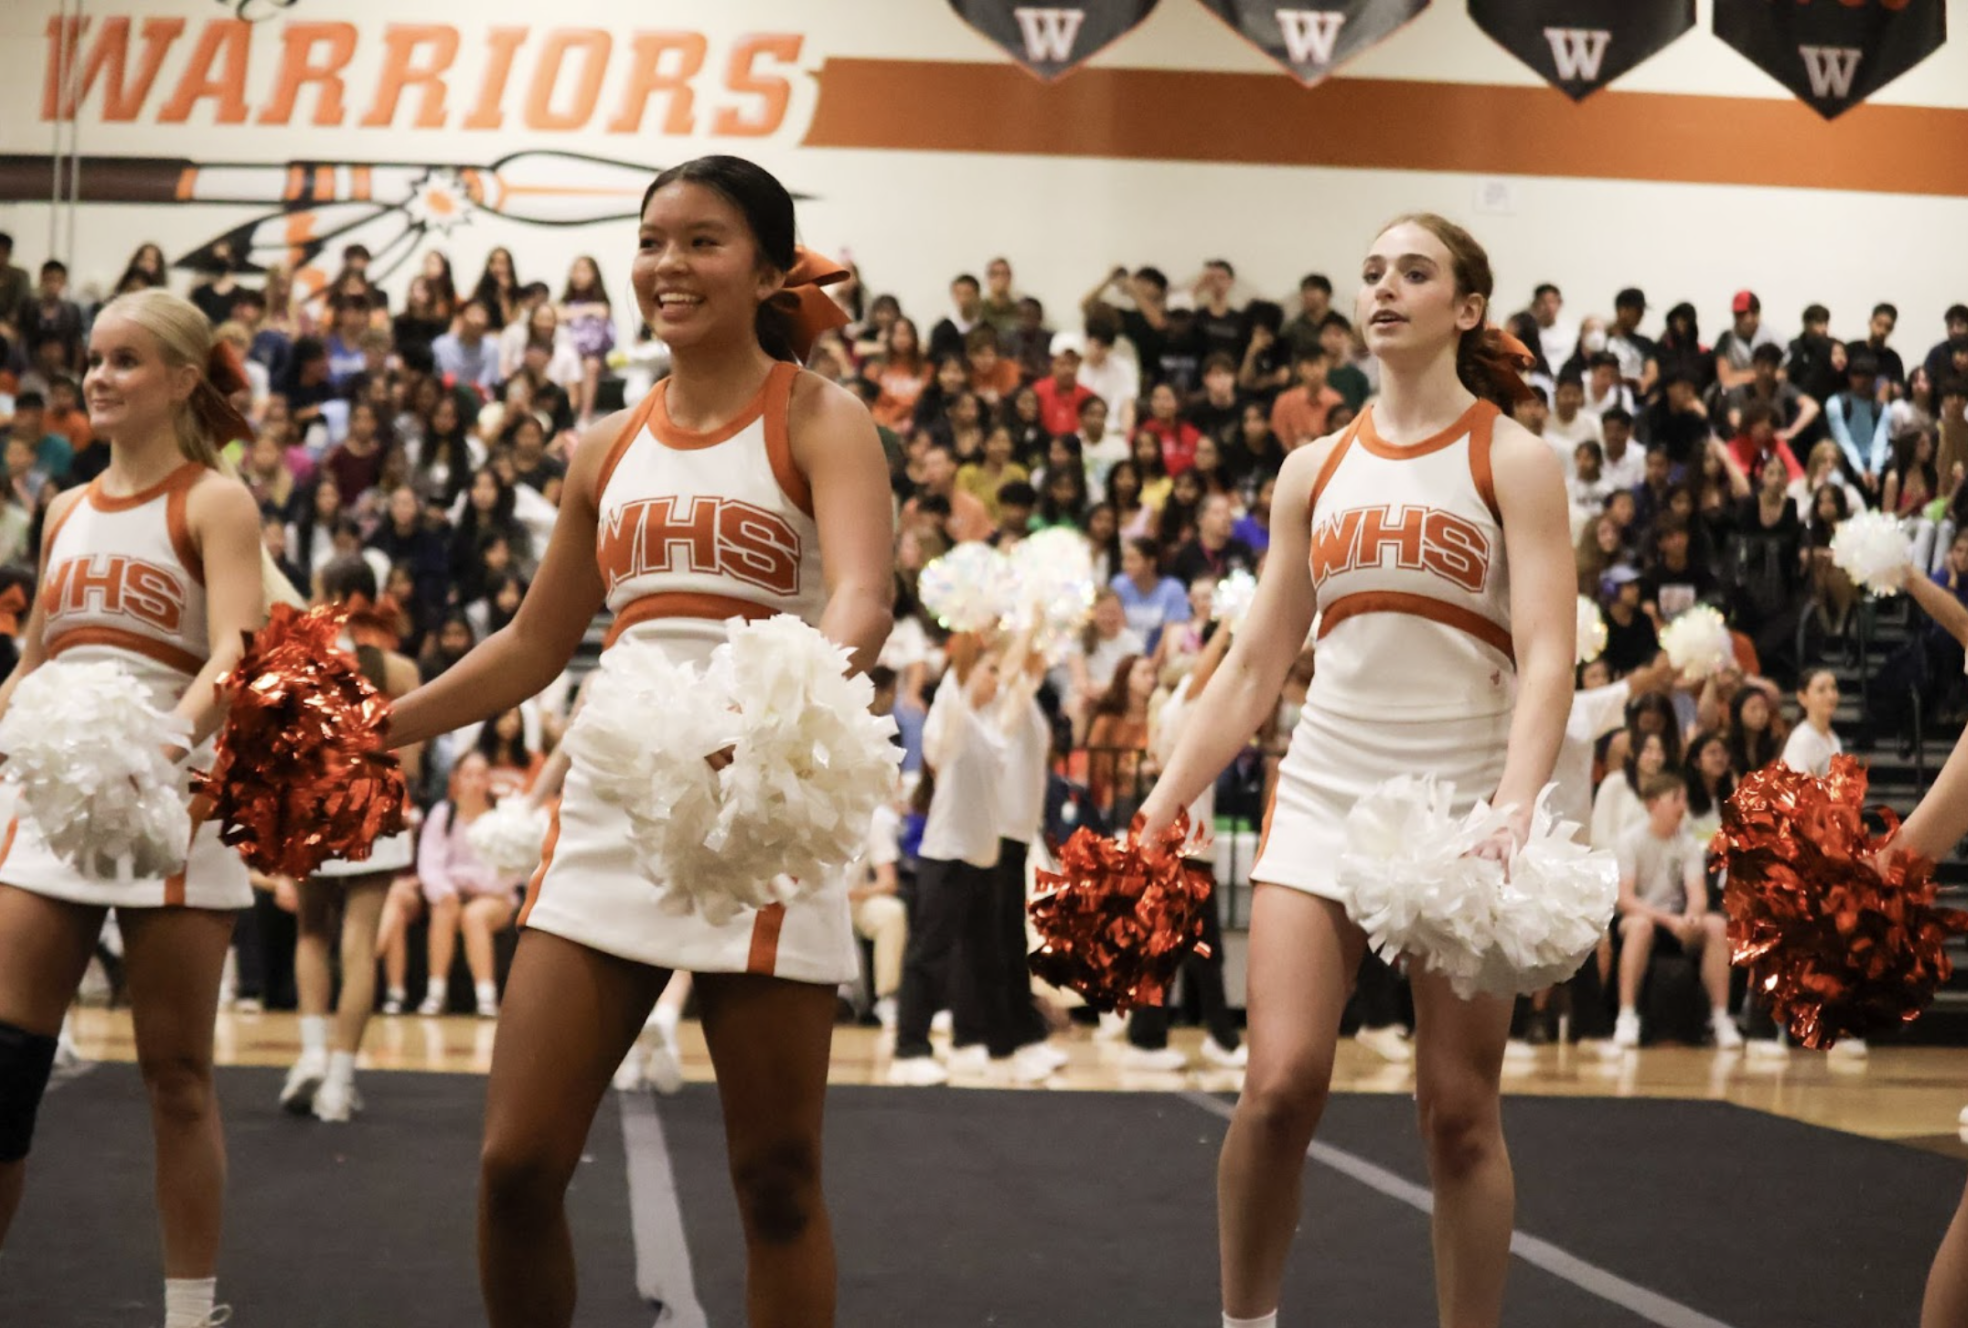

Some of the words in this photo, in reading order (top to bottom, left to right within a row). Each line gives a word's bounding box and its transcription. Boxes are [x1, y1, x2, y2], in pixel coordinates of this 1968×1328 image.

[1014, 8, 1085, 62] W
[1276, 9, 1345, 64] W
[1544, 27, 1611, 81] W
[40, 15, 805, 137] WARRIORS
[1799, 45, 1862, 98] W
[597, 495, 801, 597] WHS
[1308, 504, 1490, 593] WHS
